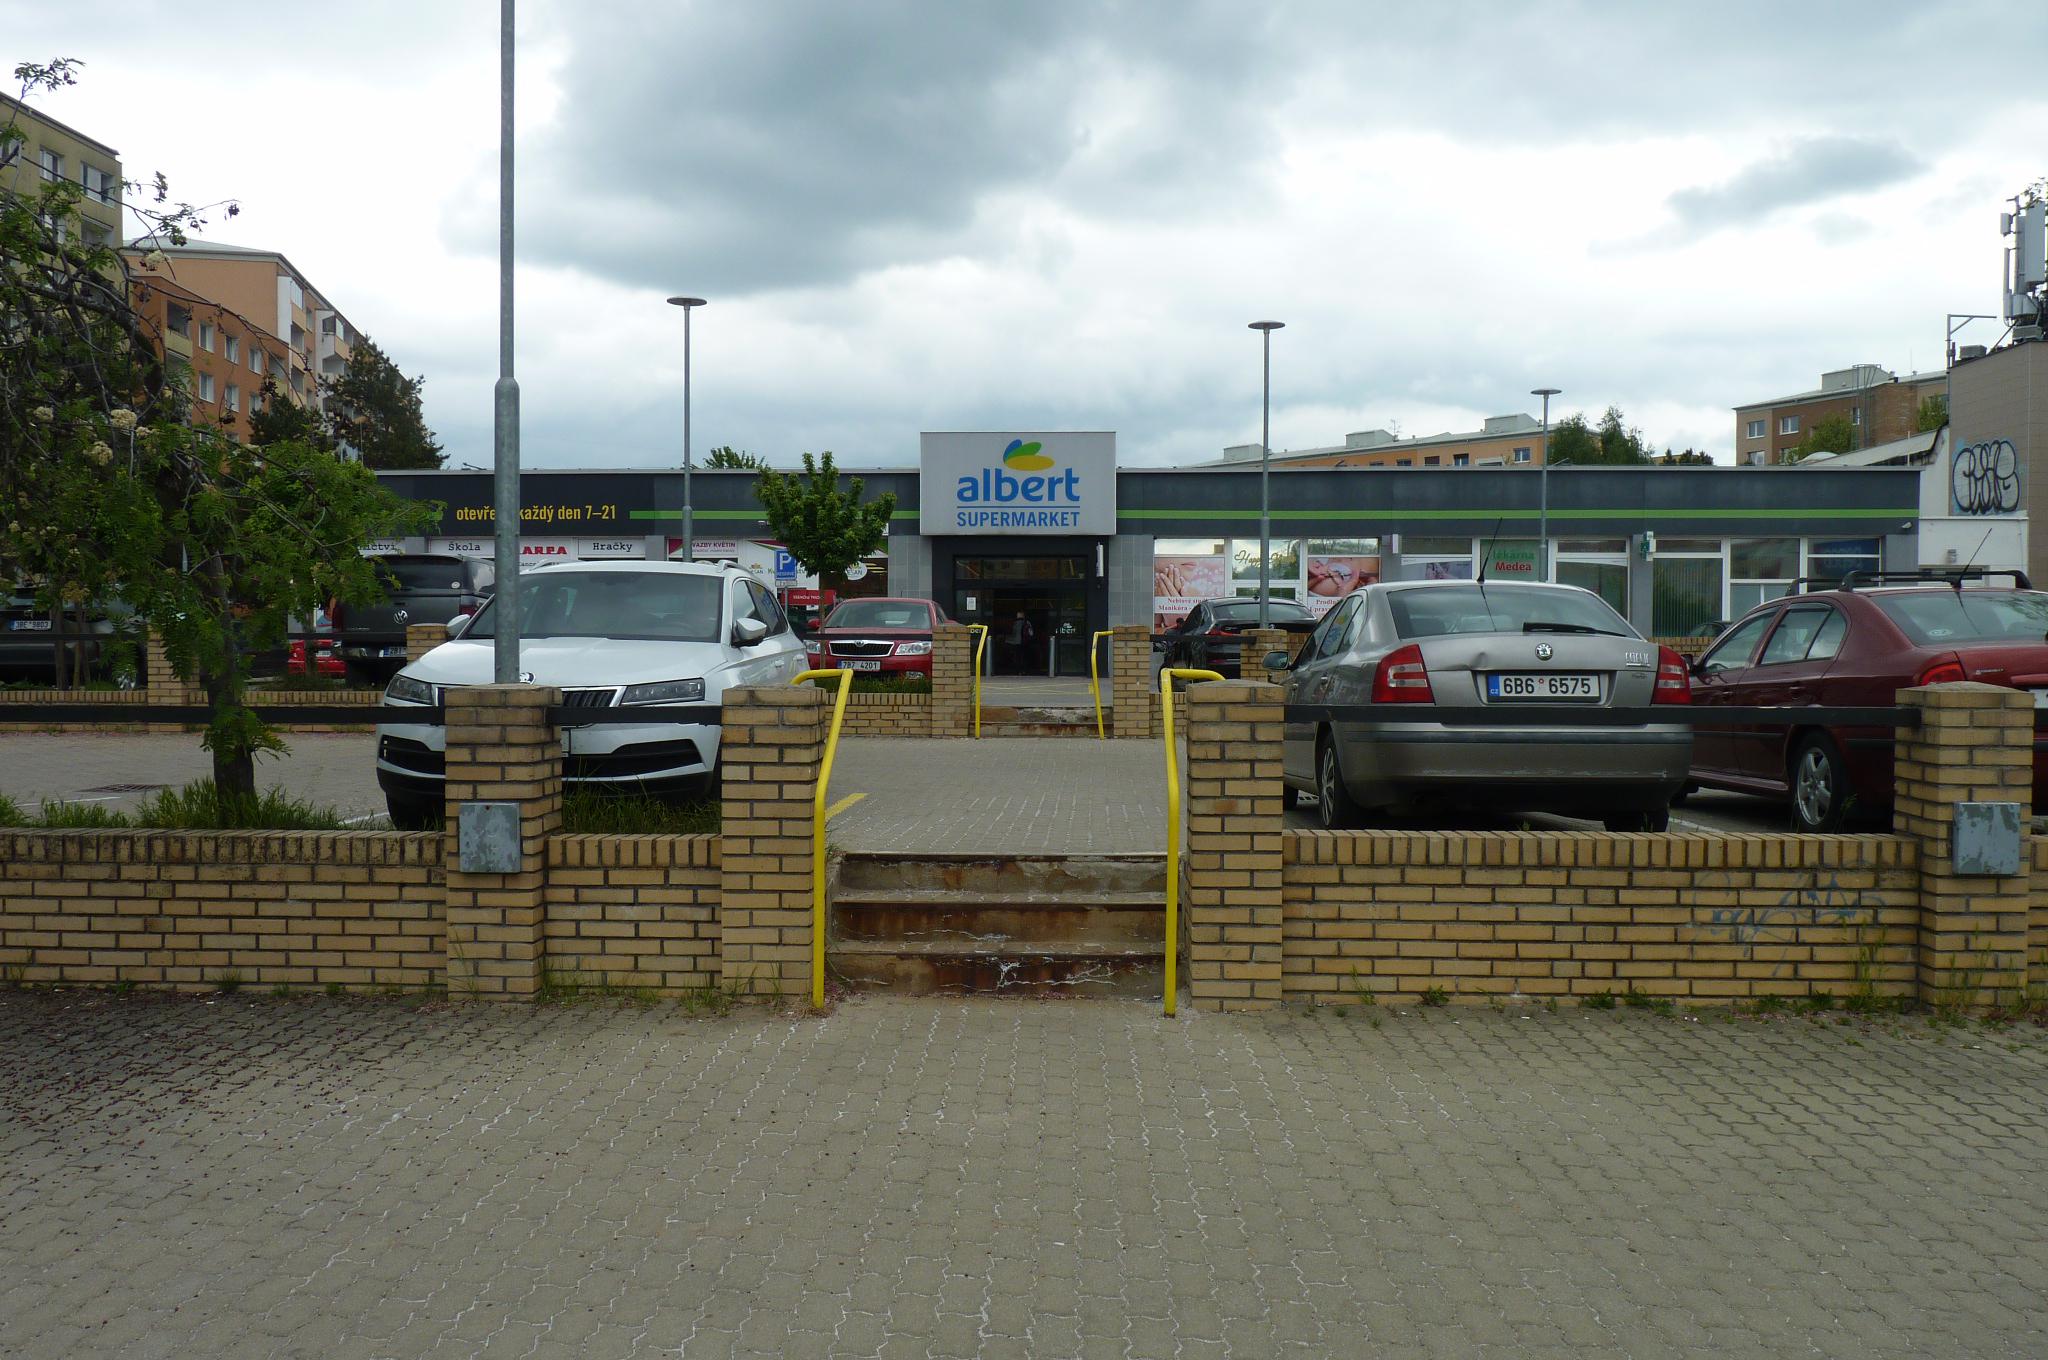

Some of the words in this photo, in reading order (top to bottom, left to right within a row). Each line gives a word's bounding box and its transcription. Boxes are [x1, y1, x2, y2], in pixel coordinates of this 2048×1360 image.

[956, 467, 1081, 502] albert
[456, 505, 496, 521] otevře
[519, 504, 554, 523] každý
[557, 505, 581, 520] den
[956, 511, 1081, 527] SUPERMARKET
[448, 541, 481, 551] Škola
[592, 542, 633, 552] Hračky
[1495, 561, 1532, 571] Medea
[860, 662, 878, 670] 4201
[1503, 678, 1535, 695] 6B6
[1549, 678, 1591, 695] 6575
